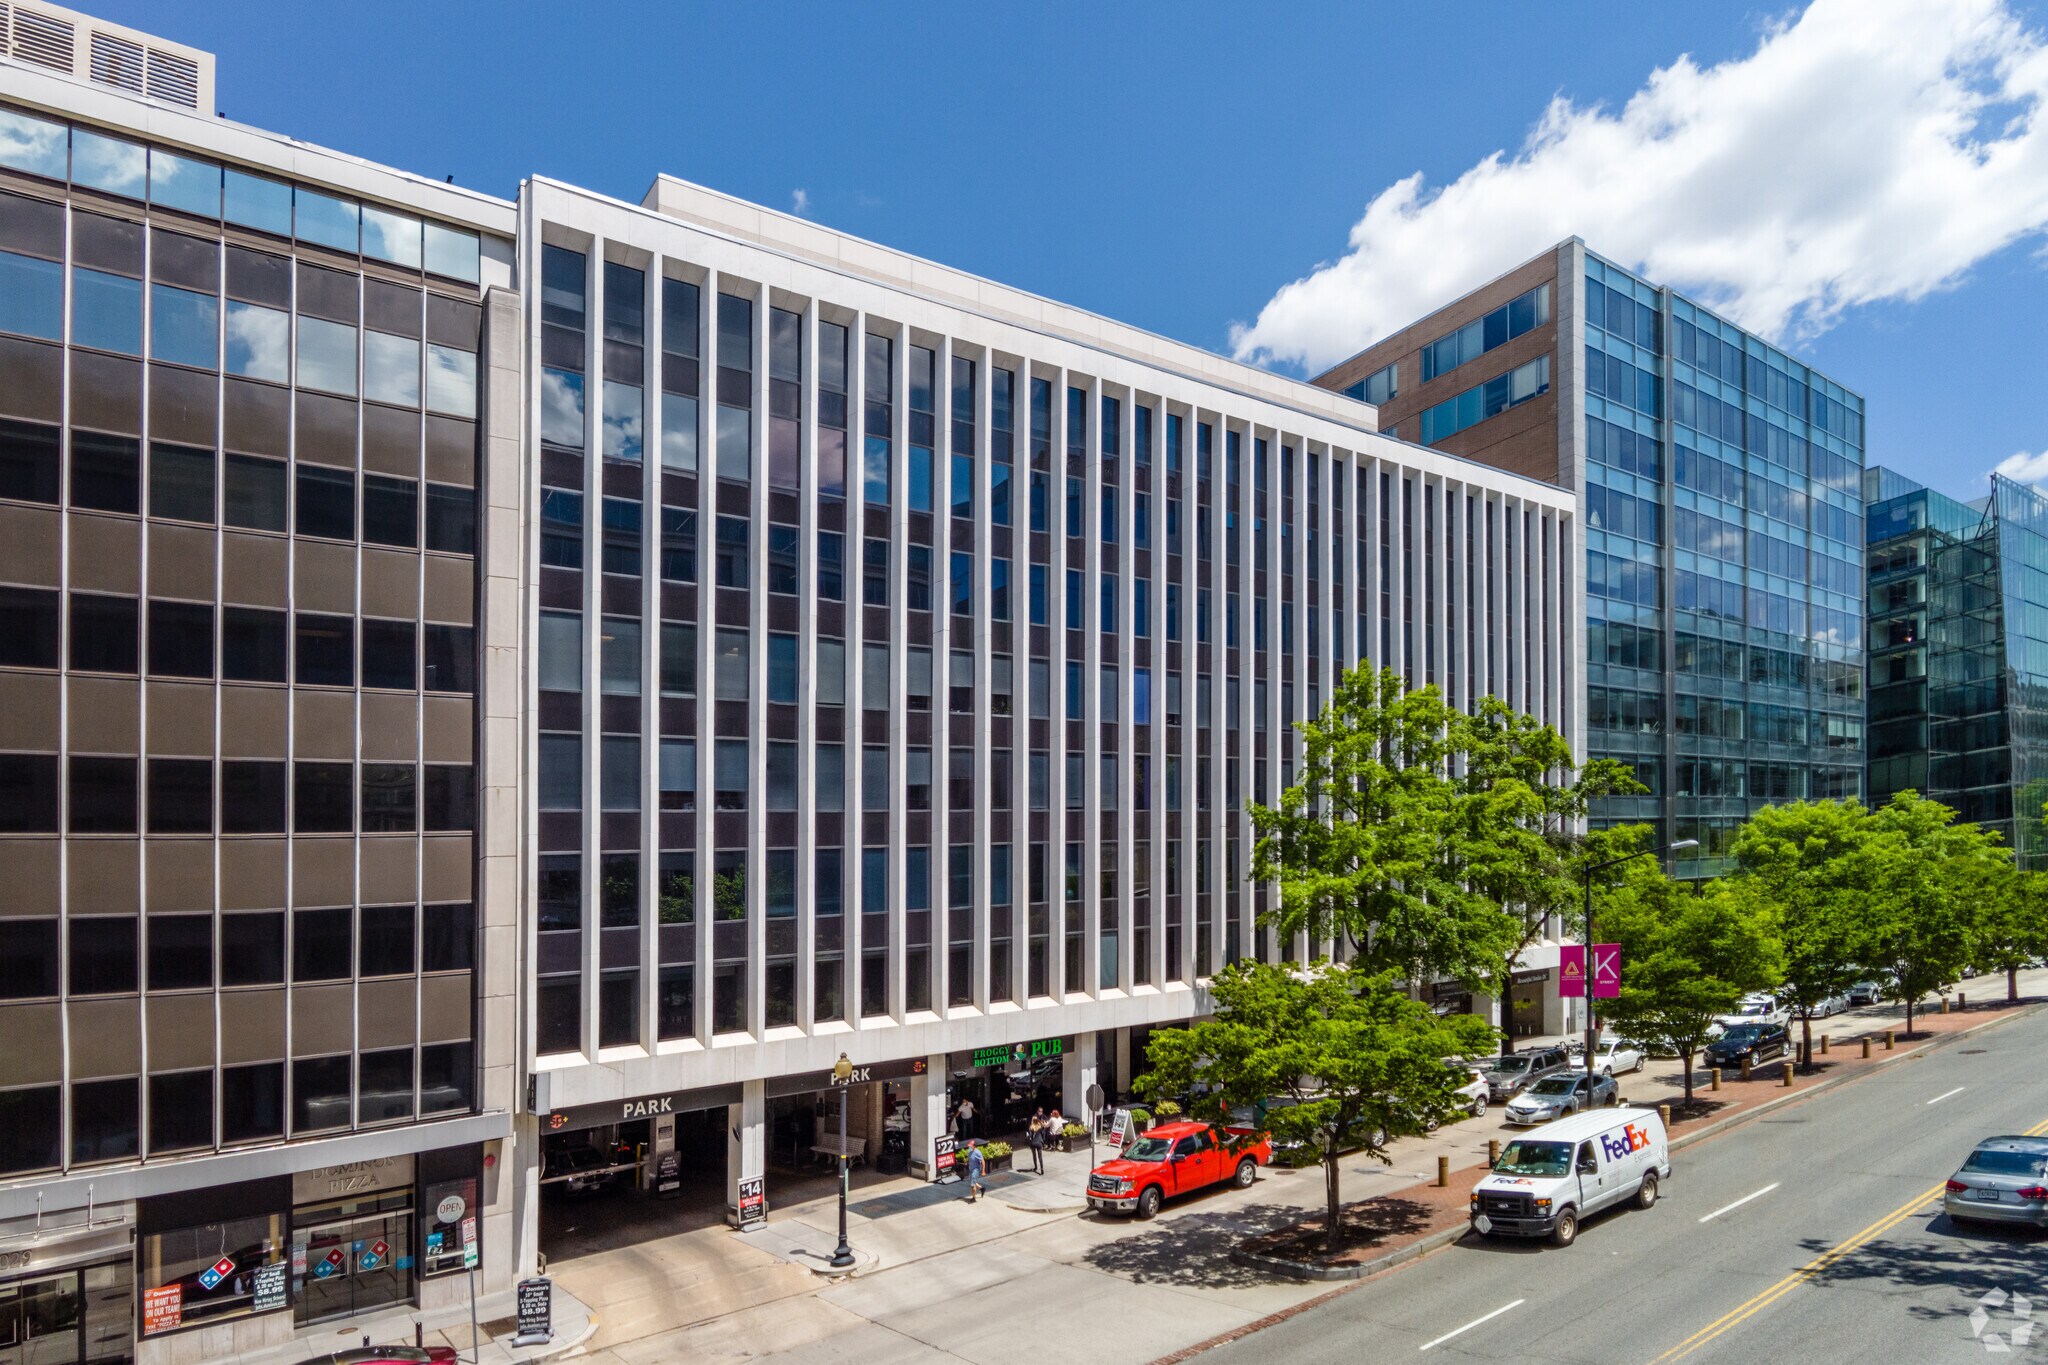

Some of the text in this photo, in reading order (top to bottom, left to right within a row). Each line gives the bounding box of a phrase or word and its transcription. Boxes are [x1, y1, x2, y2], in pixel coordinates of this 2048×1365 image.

[1595, 951, 1618, 979] K
[974, 1046, 1010, 1059] FROGGY
[1031, 1039, 1062, 1058] PUB
[974, 1055, 1010, 1068] BOTTOM
[623, 1097, 672, 1119] PARK
[937, 1140, 954, 1155] $22
[1600, 1123, 1651, 1163] FedEx
[329, 1174, 380, 1193] PIZZA
[1493, 1177, 1534, 1186] FedEx
[742, 1181, 761, 1197] $14
[440, 1202, 462, 1214] OPEN
[258, 1286, 284, 1296] $8.99
[154, 1296, 169, 1307] WANT
[154, 1306, 165, 1317] OUR
[522, 1306, 547, 1316] $8.99
